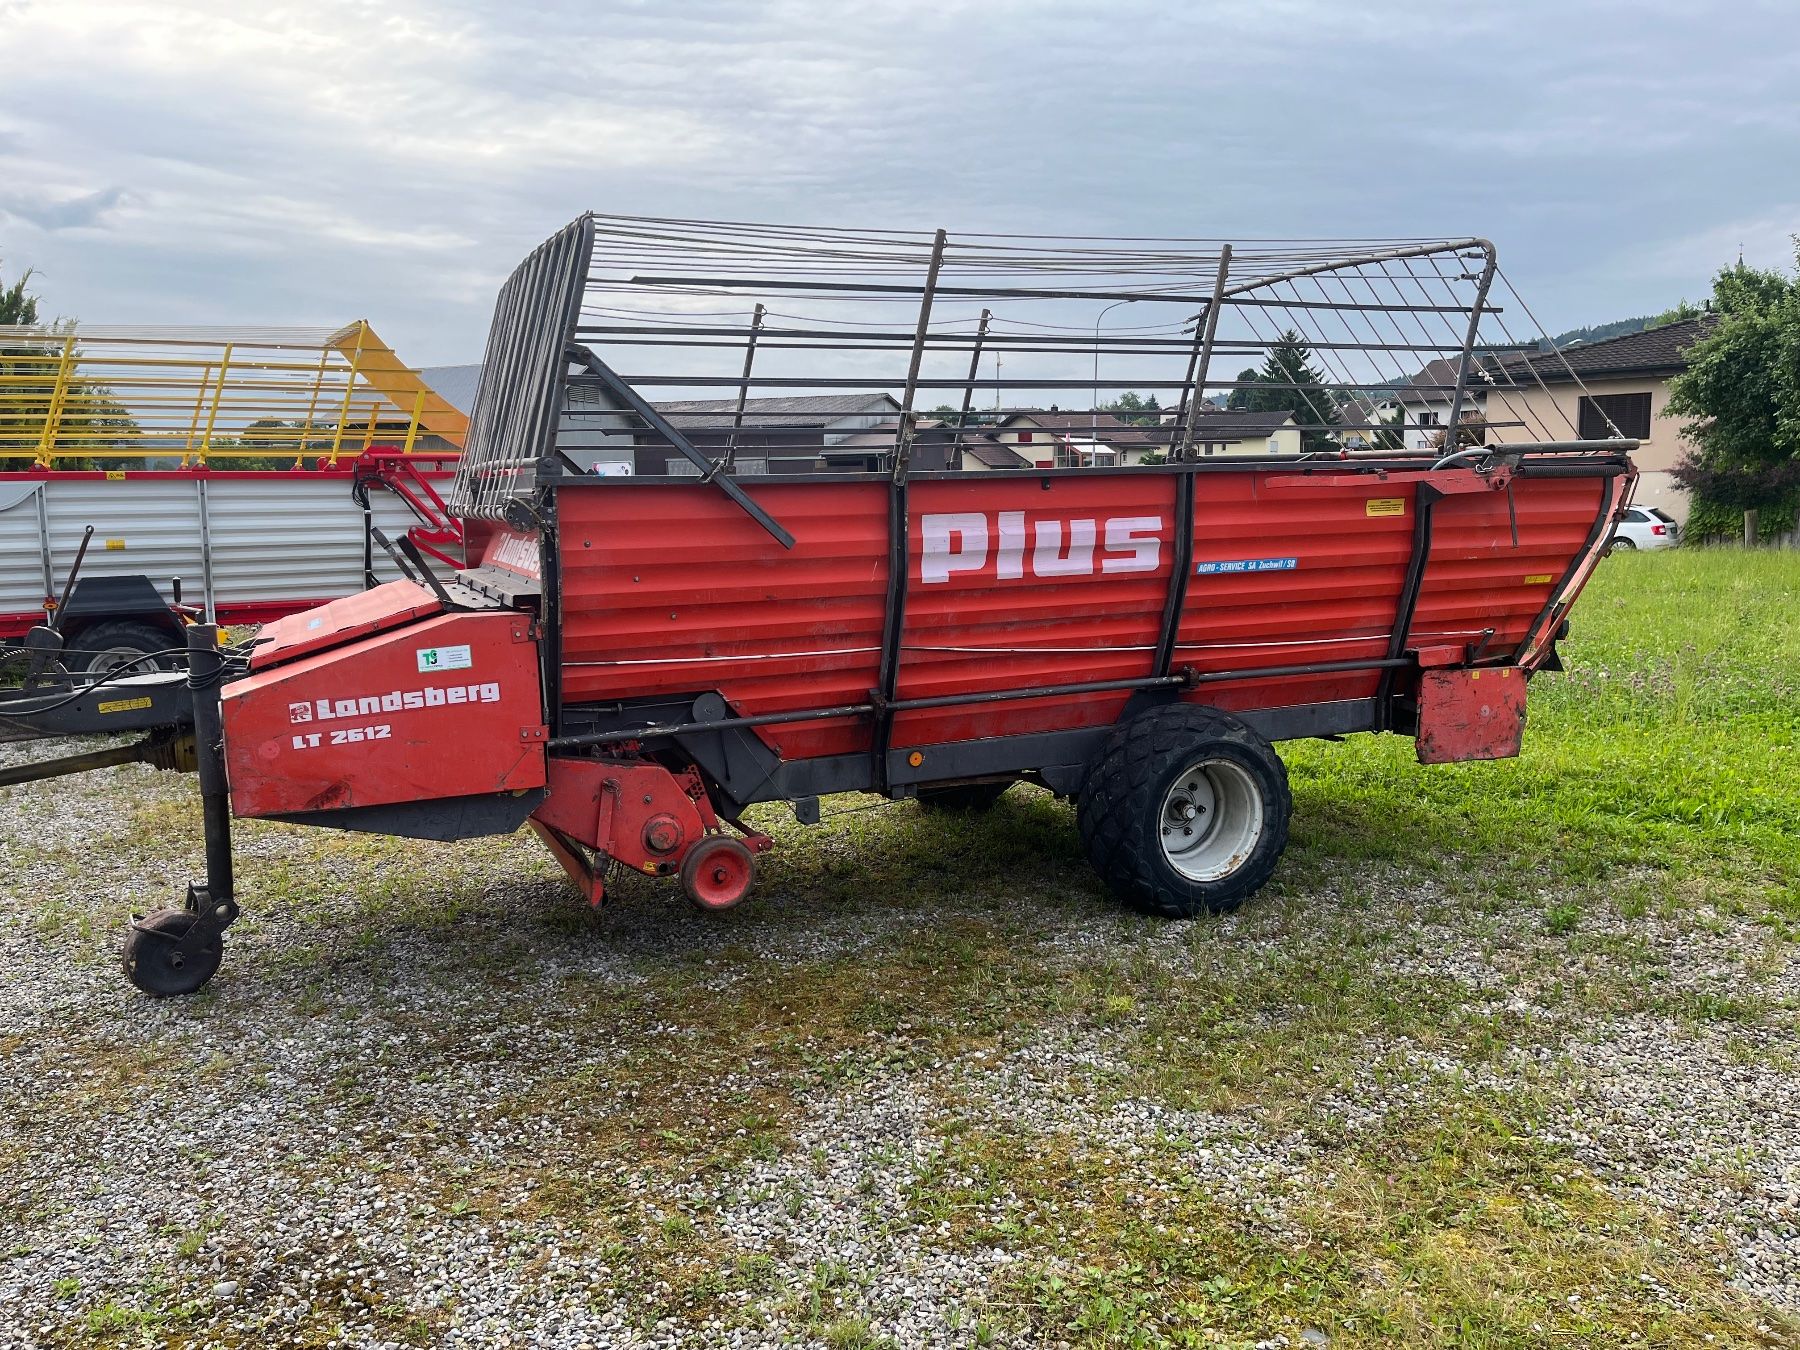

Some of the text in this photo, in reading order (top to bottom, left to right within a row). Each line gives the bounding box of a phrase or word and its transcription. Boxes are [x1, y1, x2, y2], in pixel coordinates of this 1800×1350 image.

[1247, 561, 1256, 570] SA
[316, 682, 500, 720] Landsberg
[292, 724, 392, 750] LT 2612
